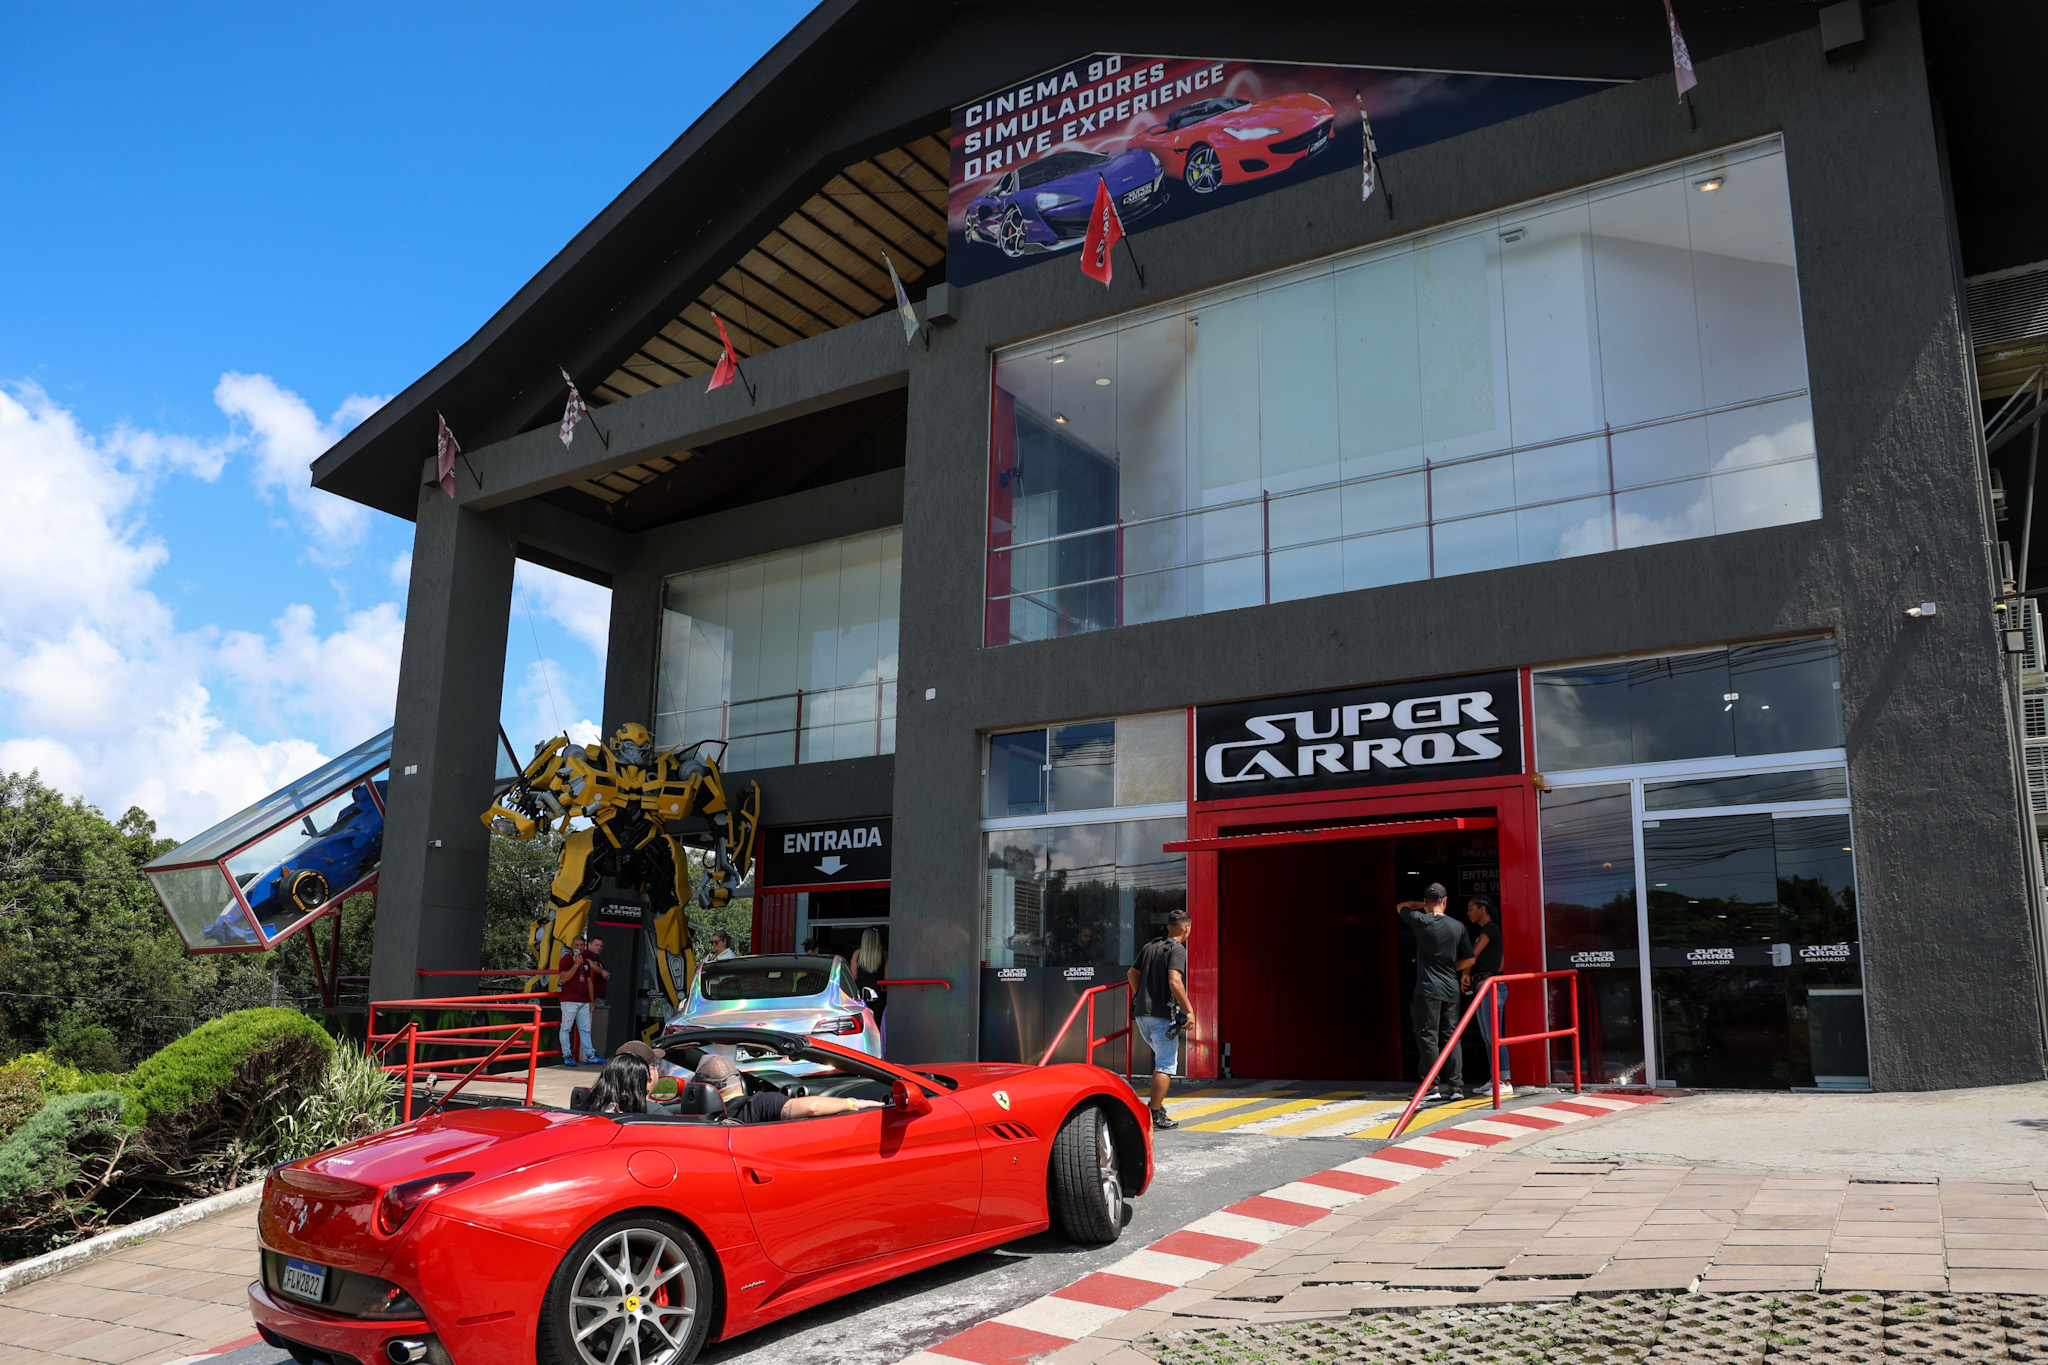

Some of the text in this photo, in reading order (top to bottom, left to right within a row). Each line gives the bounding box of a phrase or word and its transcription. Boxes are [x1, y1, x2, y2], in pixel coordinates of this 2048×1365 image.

[964, 54, 1122, 128] CINEMA 9D
[963, 62, 1166, 155] SIMULADORES
[963, 63, 1225, 182] DRIVE EXPERIENCE
[1244, 690, 1500, 744] SUPER
[1204, 726, 1503, 785] CARROS
[783, 826, 883, 854] ENTRADA
[1462, 868, 1500, 880] ENTRAD
[1473, 882, 1487, 892] DE
[1570, 955, 1615, 963] CARROS
[1686, 952, 1735, 960] CARROS
[1799, 949, 1851, 957] CARROS
